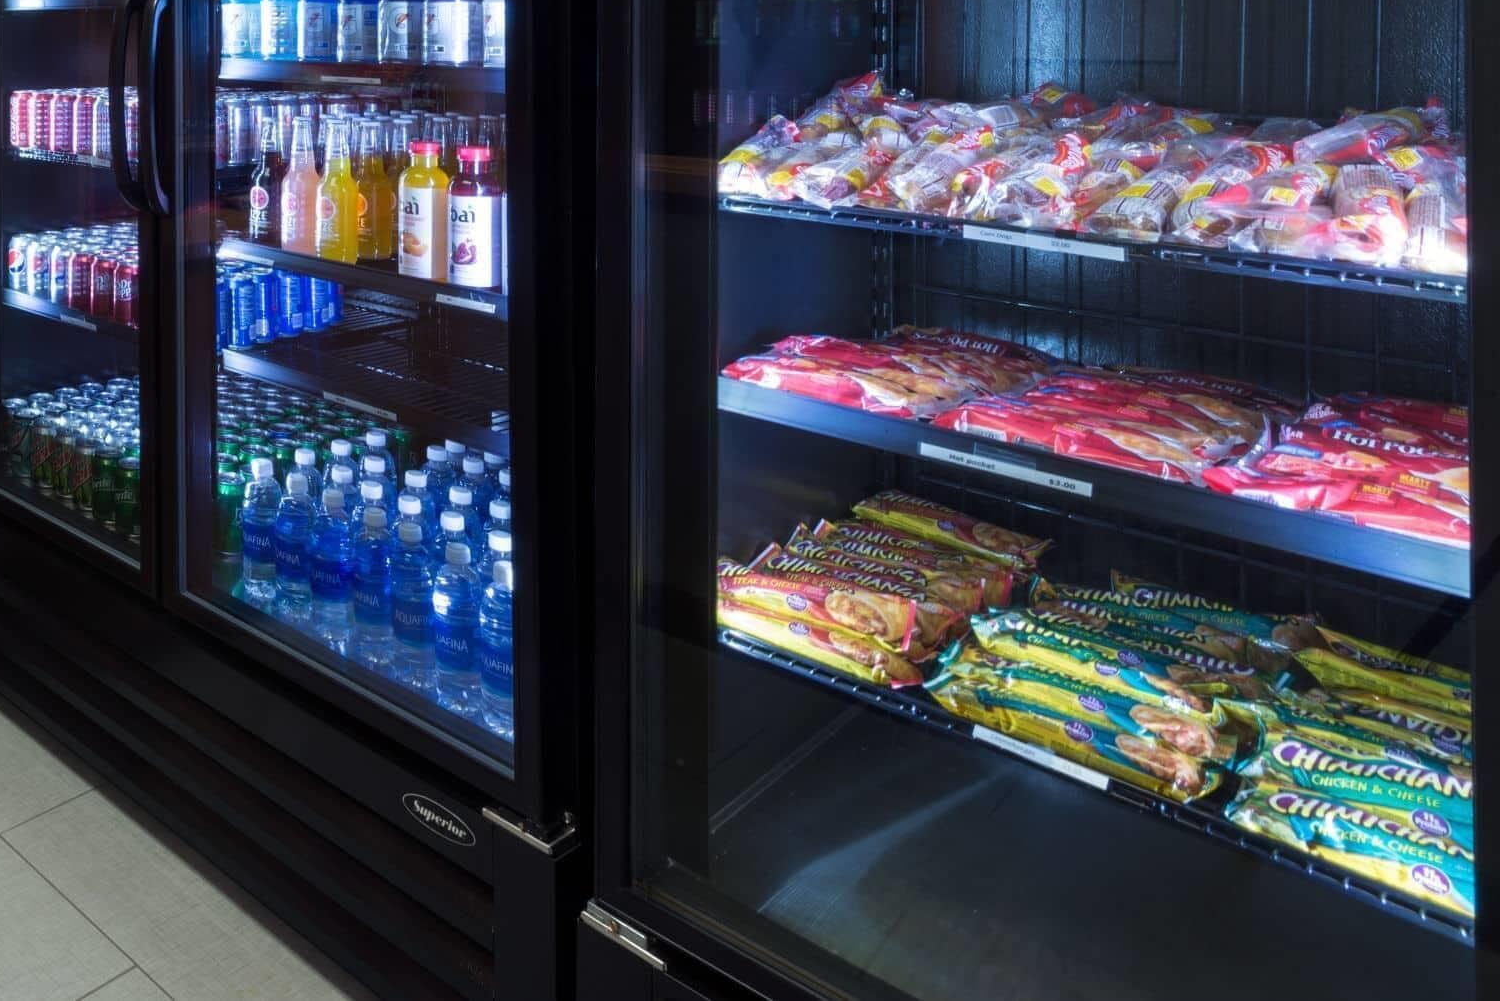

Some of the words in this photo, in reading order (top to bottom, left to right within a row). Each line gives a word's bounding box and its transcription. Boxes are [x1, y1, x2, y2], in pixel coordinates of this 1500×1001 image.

[1311, 773, 1368, 792] CHICKEN
[1371, 784, 1383, 795] &
[1387, 788, 1442, 808] CHEESE
[413, 799, 467, 838] Superior
[1387, 839, 1444, 864] CHEESE
